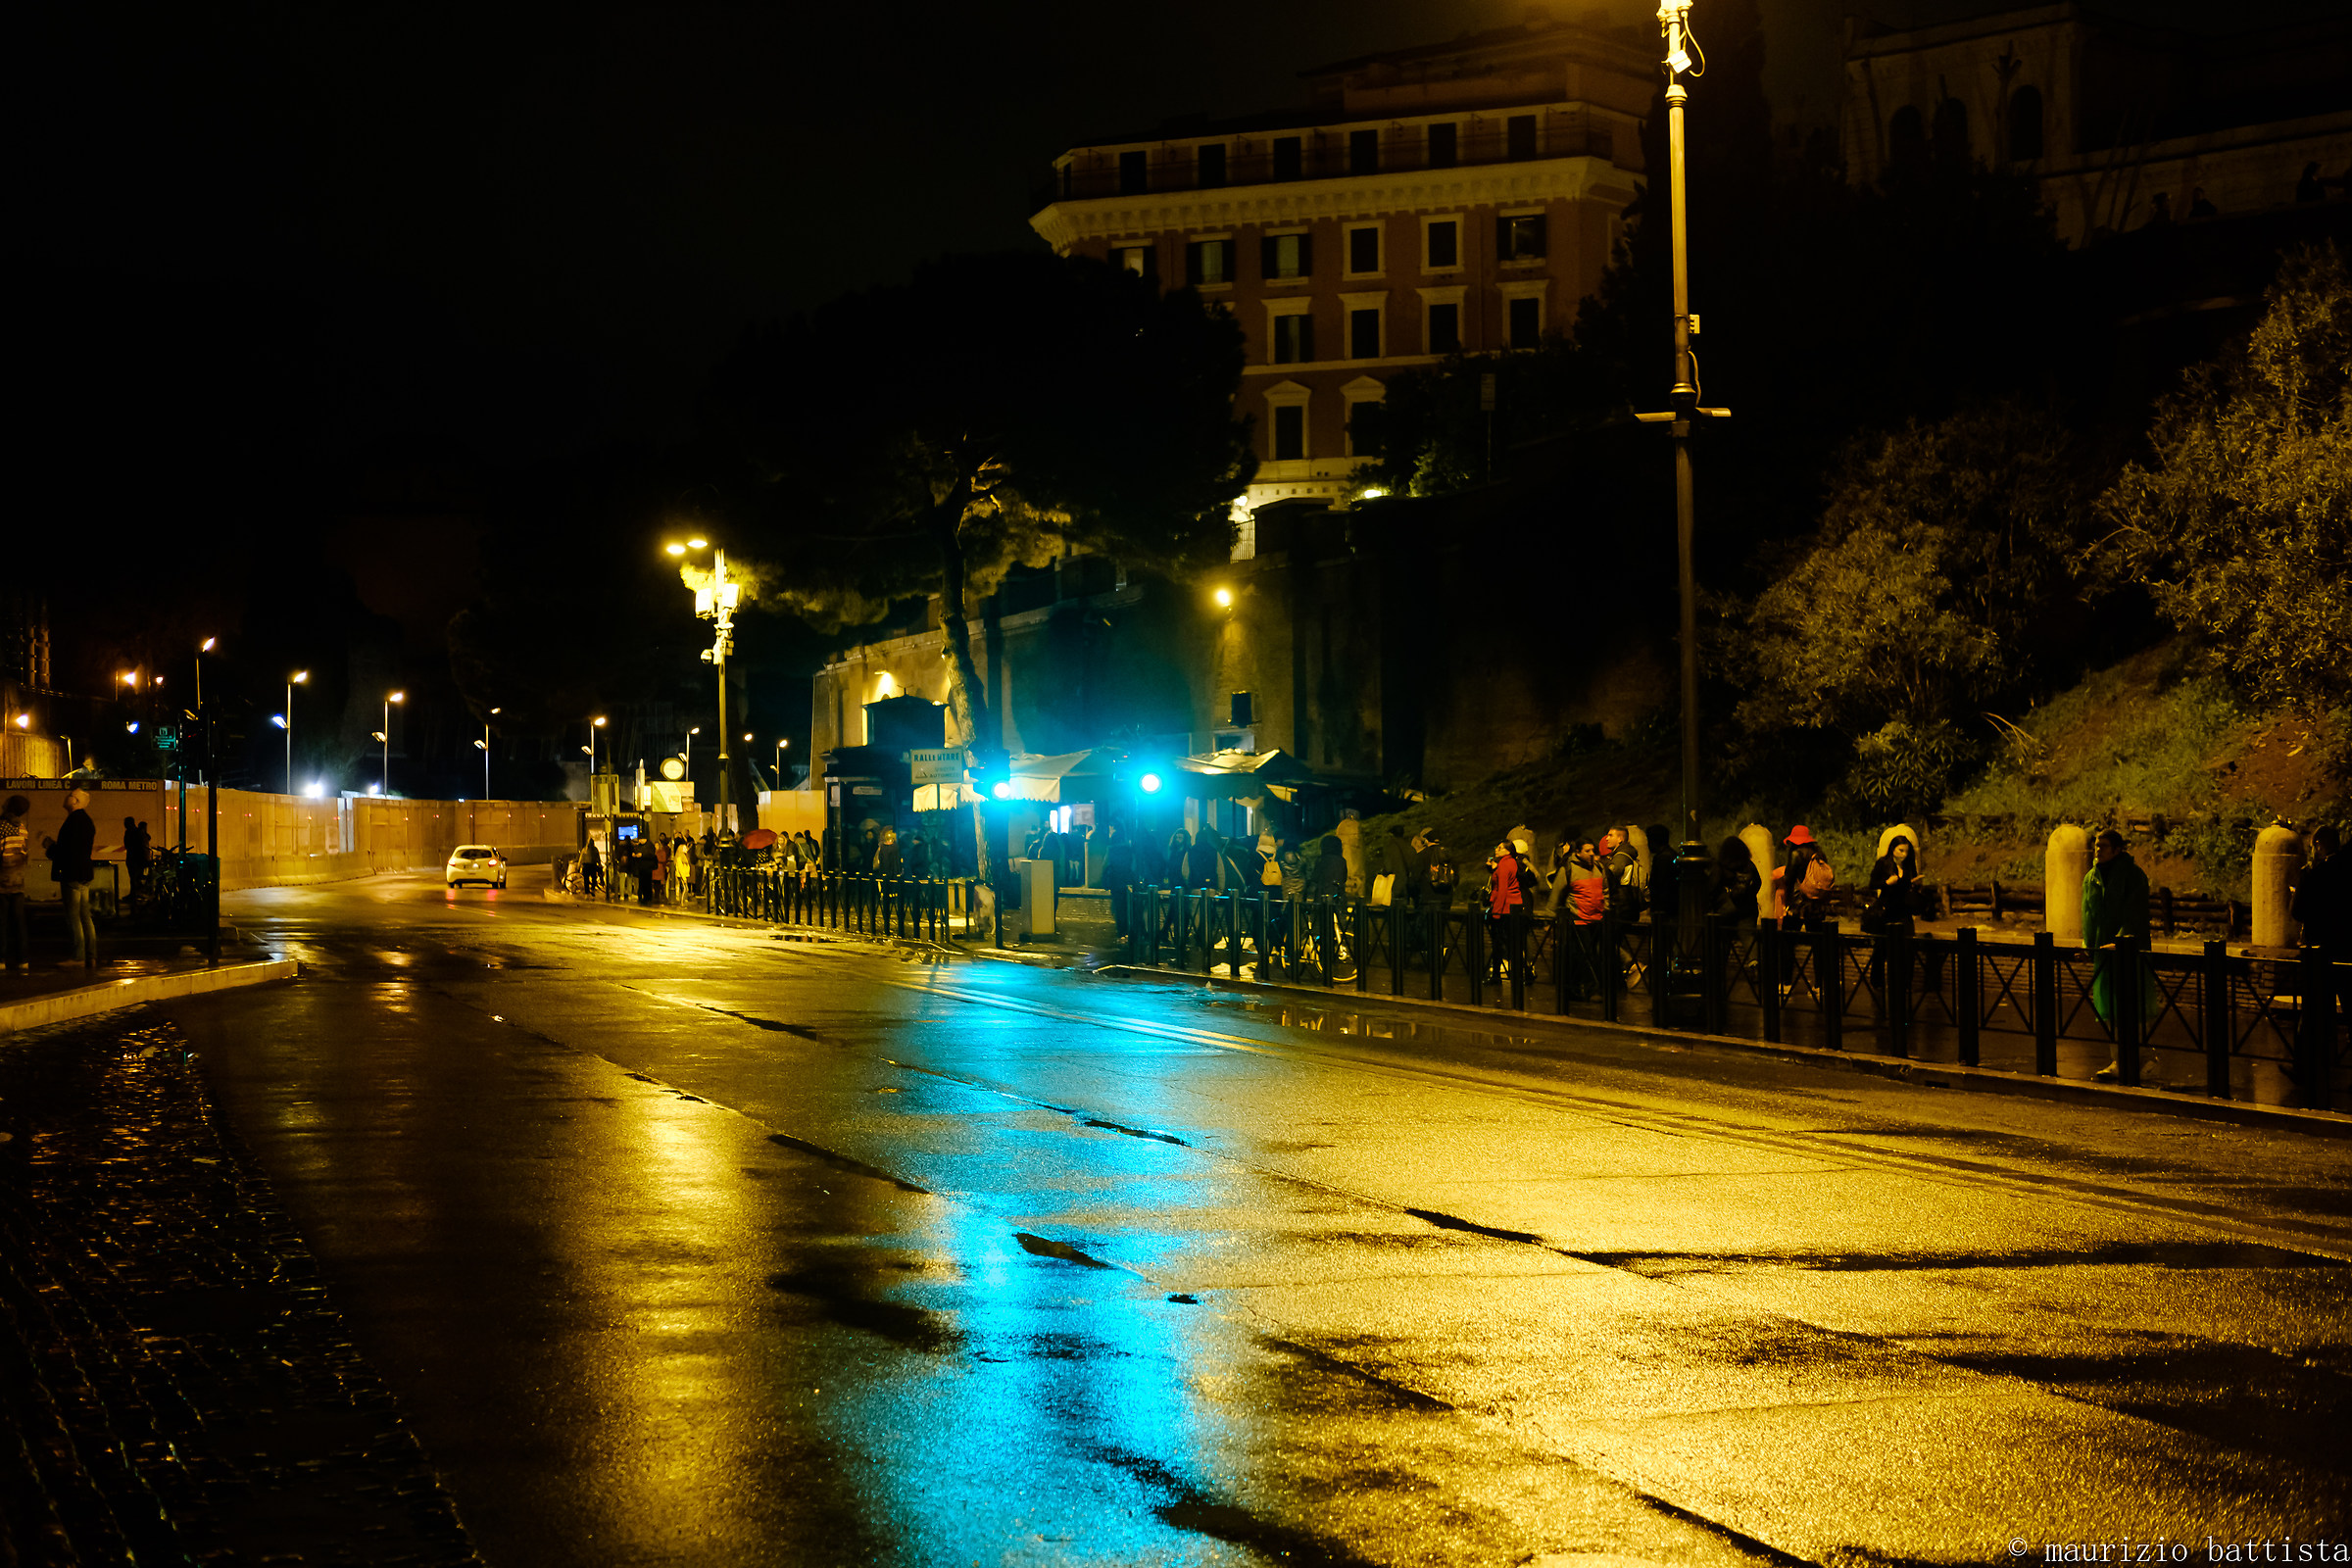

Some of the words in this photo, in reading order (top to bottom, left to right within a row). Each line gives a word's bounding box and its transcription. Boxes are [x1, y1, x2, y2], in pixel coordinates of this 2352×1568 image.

[913, 753, 959, 761] RALLENTARE
[6, 780, 36, 789] LAVORI
[38, 780, 63, 789] LINEA
[65, 780, 71, 789] C
[101, 781, 126, 790] ROMA
[128, 781, 157, 791] METRO
